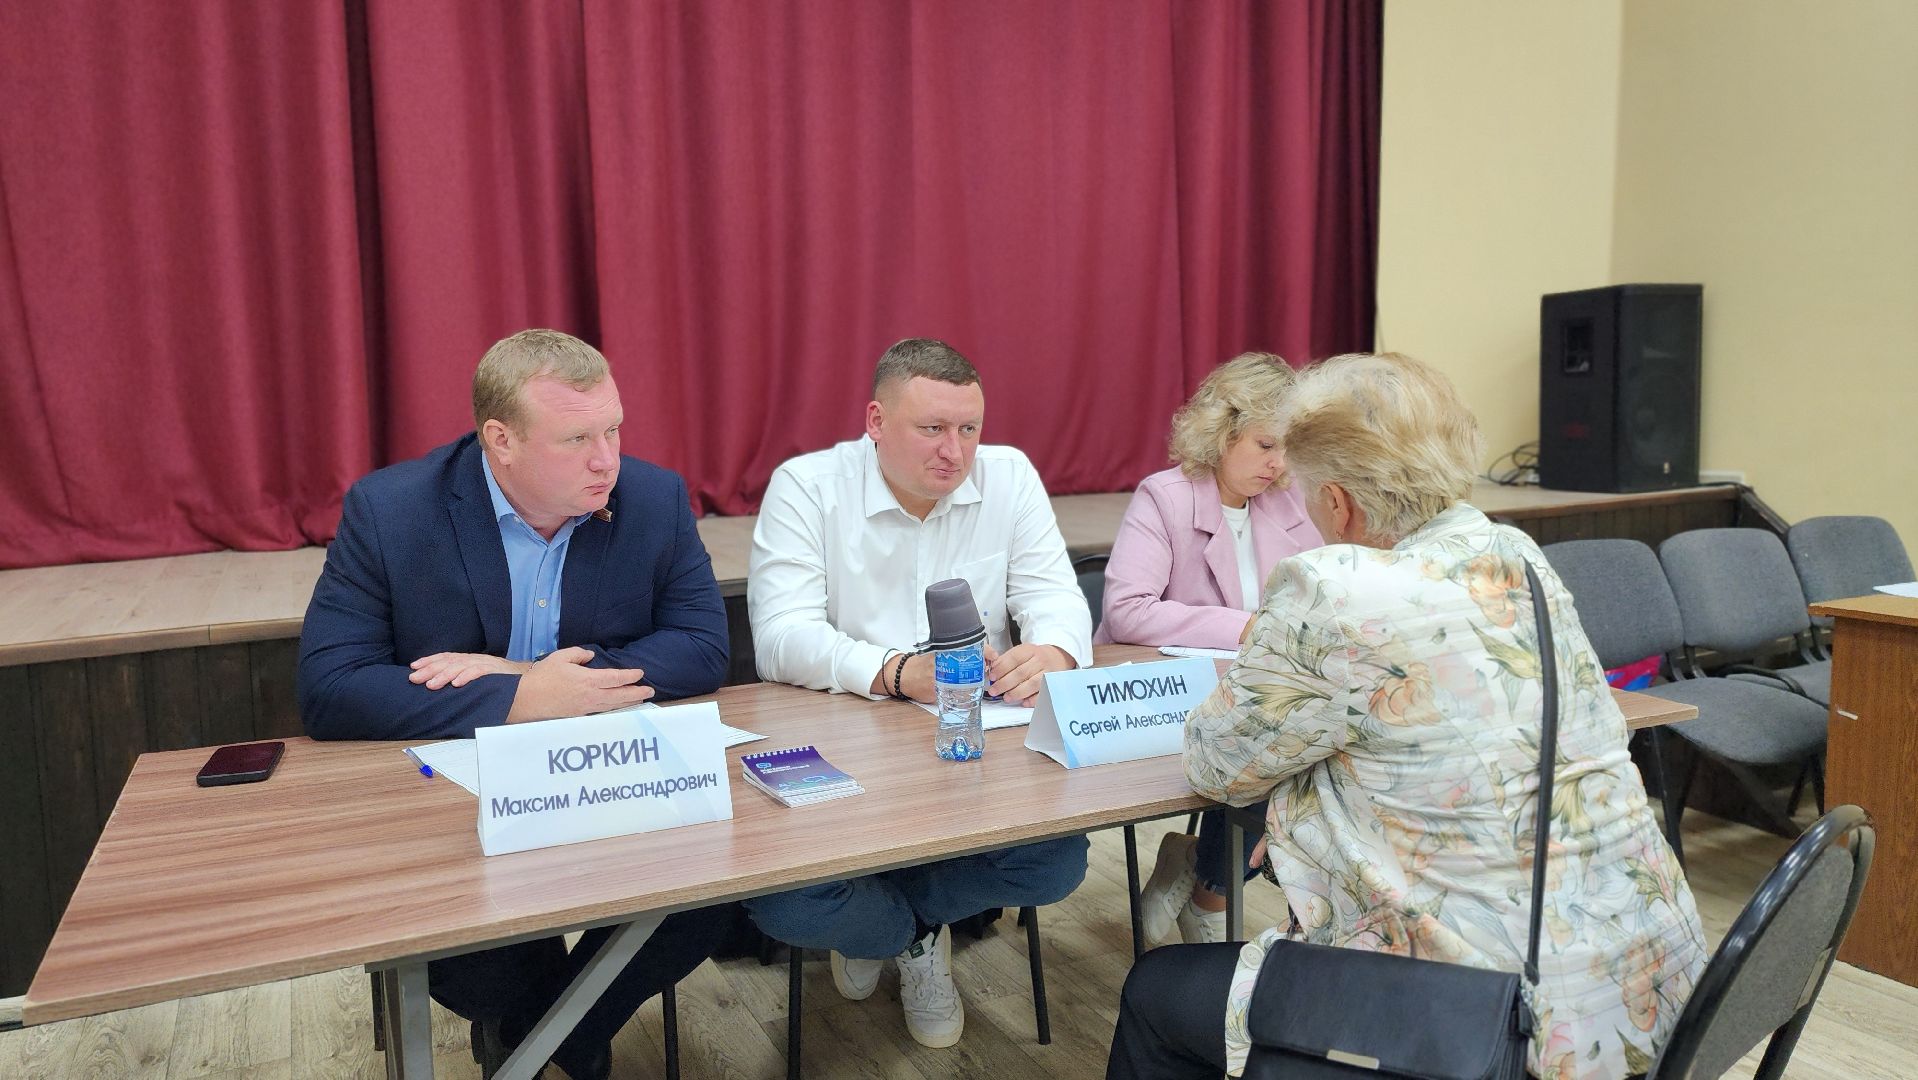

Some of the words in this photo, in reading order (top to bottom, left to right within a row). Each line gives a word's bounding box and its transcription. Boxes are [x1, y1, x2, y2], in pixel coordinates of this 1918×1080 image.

[1087, 675, 1187, 705] ТИМОХИН
[1069, 716, 1121, 738] Сергей
[548, 737, 660, 774] КОРКИН
[491, 795, 570, 818] Максим
[577, 773, 718, 806] Александрович
